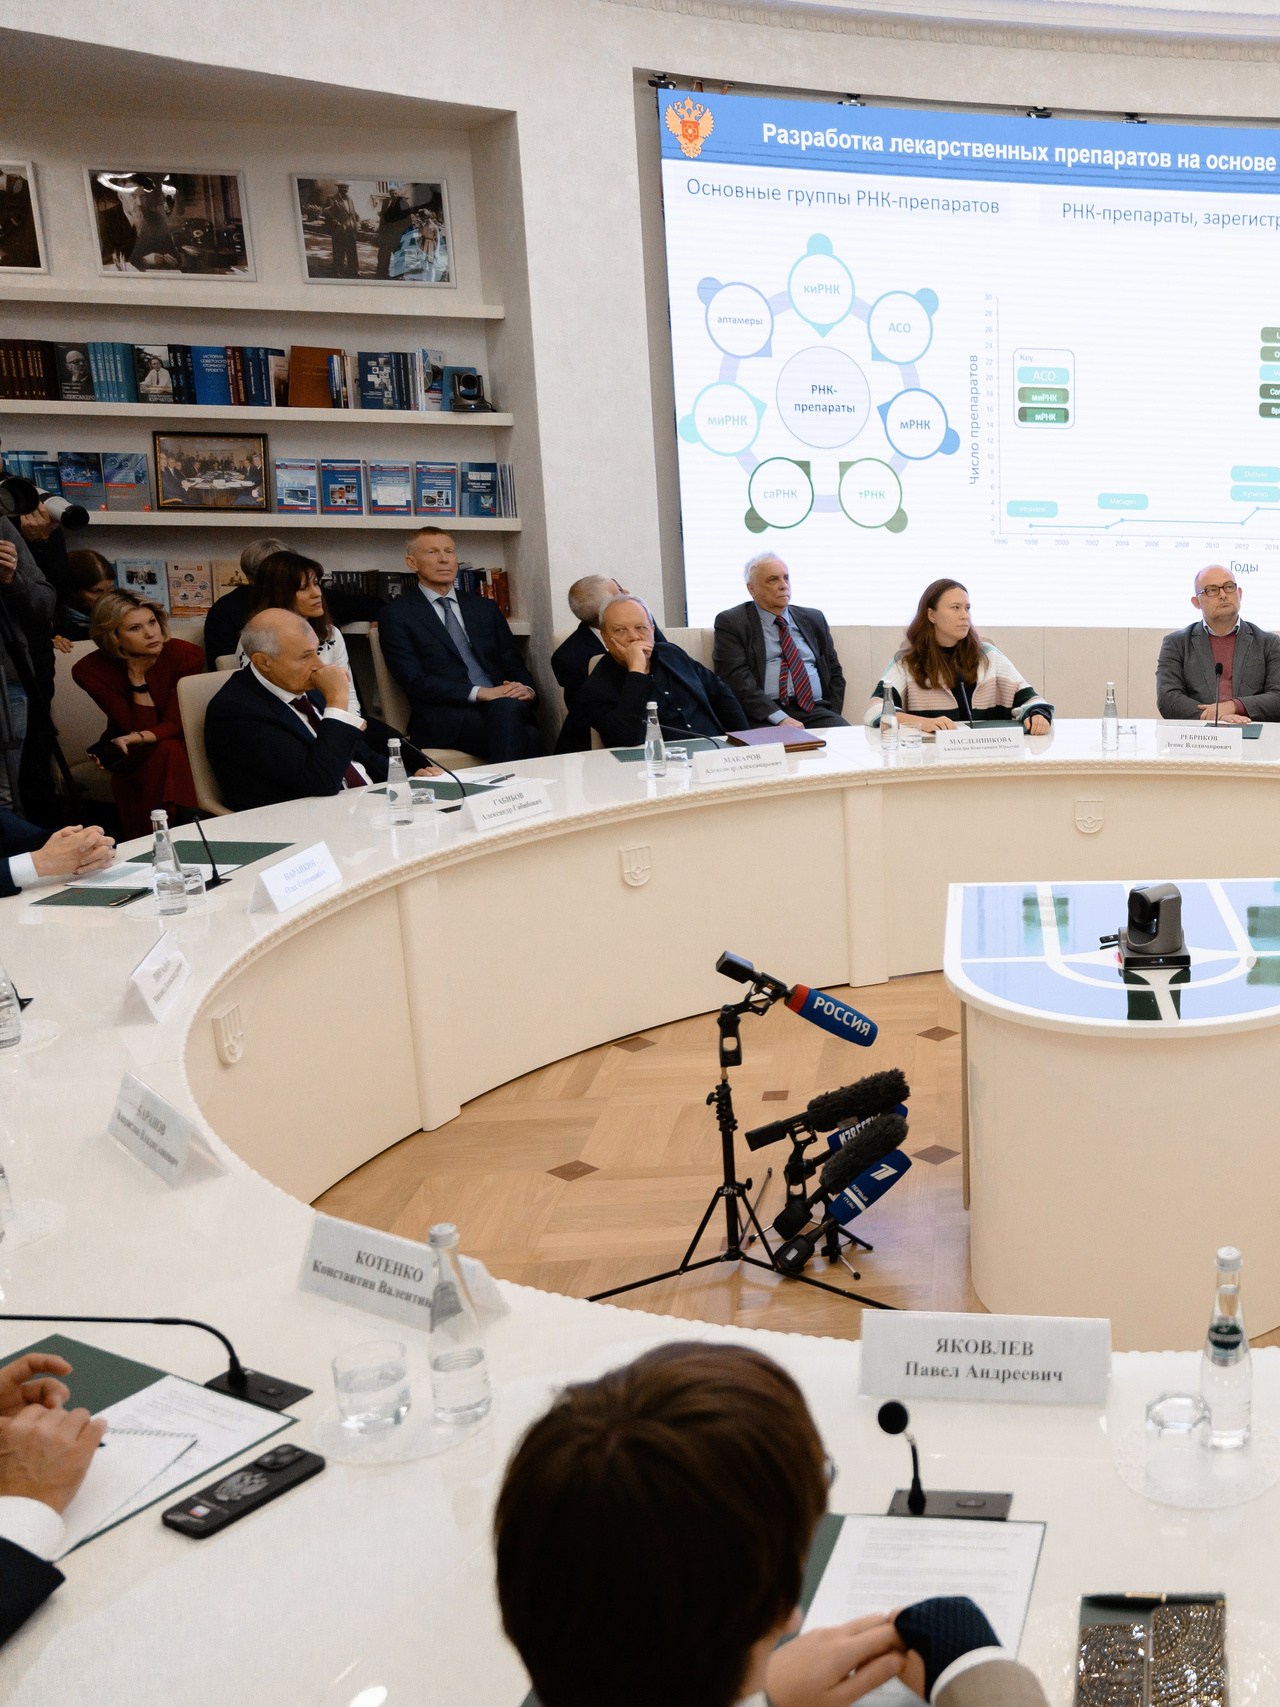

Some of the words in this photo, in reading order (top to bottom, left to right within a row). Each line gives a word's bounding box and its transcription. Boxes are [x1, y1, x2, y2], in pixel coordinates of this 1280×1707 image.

[762, 122, 884, 153] Разработка
[888, 136, 1049, 163] лекарственных
[1054, 148, 1172, 170] препаратов
[1177, 152, 1200, 169] на
[1205, 154, 1277, 173] основе
[686, 178, 782, 202] Основные
[787, 186, 852, 208] группы
[856, 189, 1000, 217] РНК-препаратов
[1062, 202, 1199, 228] РНК-препараты,
[803, 283, 841, 296] киРНК
[717, 315, 764, 327] аптамеры
[888, 322, 912, 334] АСО
[1032, 371, 1056, 381] АСО
[811, 384, 838, 395] РНК-
[969, 354, 981, 438] препаратов
[794, 402, 856, 414] препараты
[707, 415, 748, 426] миРНК
[1035, 413, 1057, 421] мРНК
[900, 419, 931, 430] мРНК
[969, 442, 980, 485] Число
[858, 489, 886, 500] тРНК
[1229, 561, 1259, 574] Годы
[723, 753, 762, 764] МАКАРОВ
[492, 792, 525, 806] ГАБИБОВ
[482, 807, 513, 821] Александр
[813, 996, 871, 1037] РОССИЯ
[851, 1184, 869, 1203] ПЕРВЫЙ
[355, 1250, 424, 1283] КОТЕНКО
[312, 1259, 376, 1291] Константин
[377, 1280, 433, 1309] Валентин
[935, 1337, 1034, 1357] ЯКОВЛЕВ
[904, 1360, 960, 1379] Павел
[965, 1364, 1064, 1384] Андреевич
